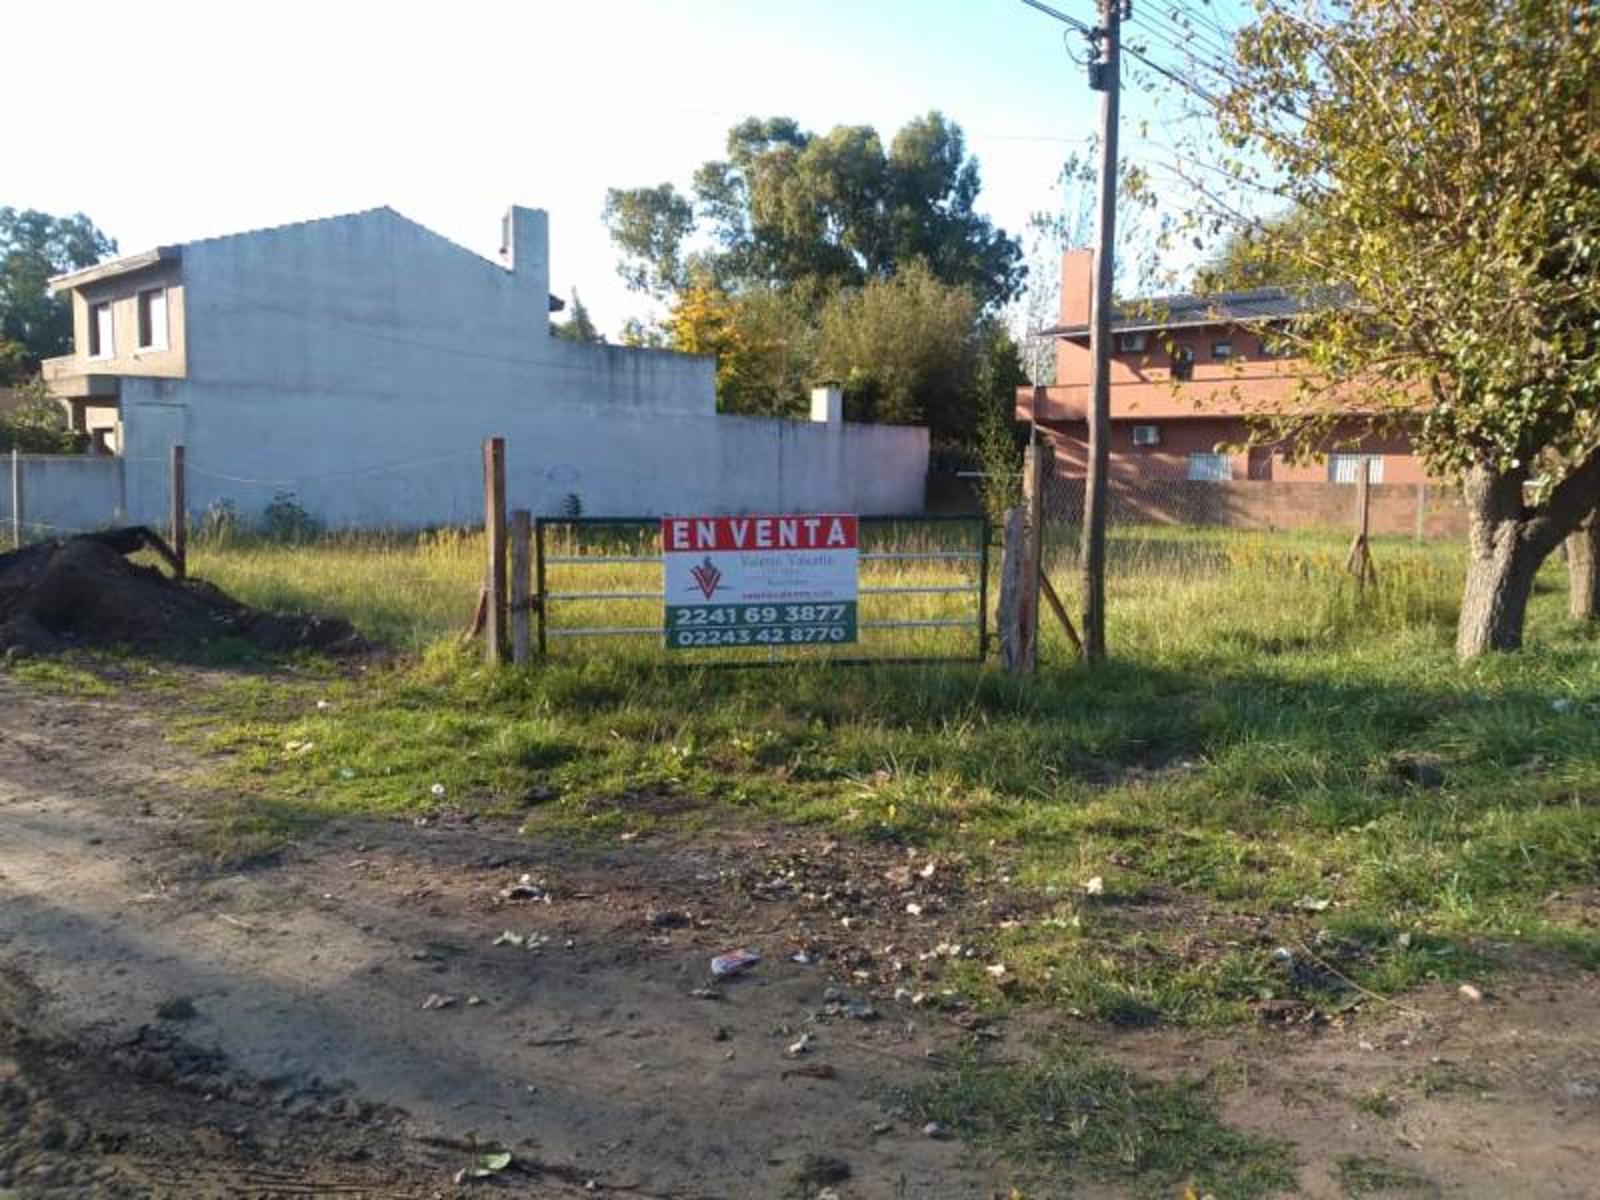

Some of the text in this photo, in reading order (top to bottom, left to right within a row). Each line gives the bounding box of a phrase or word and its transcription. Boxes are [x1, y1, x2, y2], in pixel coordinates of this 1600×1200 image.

[672, 518, 846, 549] EN VENTA
[676, 604, 846, 625] 2241 69 3877
[678, 627, 845, 645] 02243 42 8770
